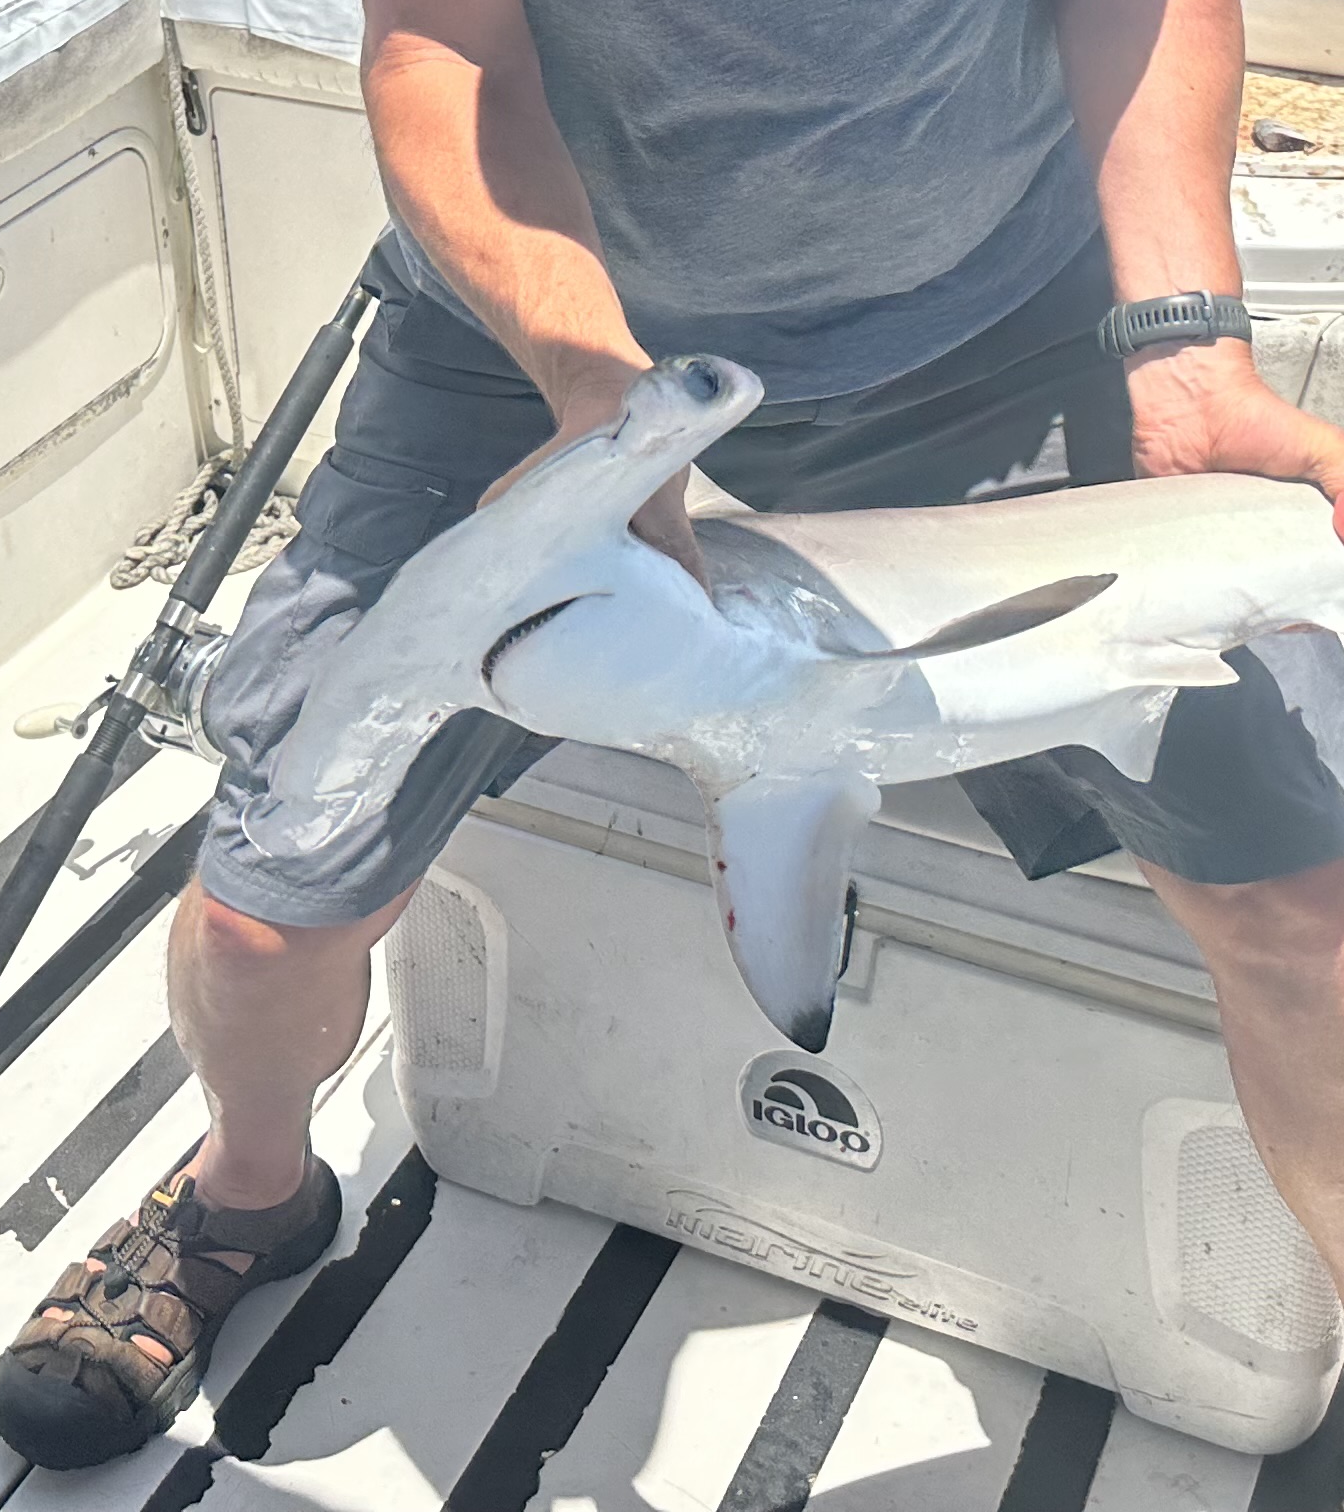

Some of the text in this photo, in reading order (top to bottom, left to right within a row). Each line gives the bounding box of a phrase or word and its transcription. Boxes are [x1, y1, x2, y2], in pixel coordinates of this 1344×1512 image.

[752, 1099, 870, 1153] IGLOO
[665, 1206, 979, 1333] marine elite
